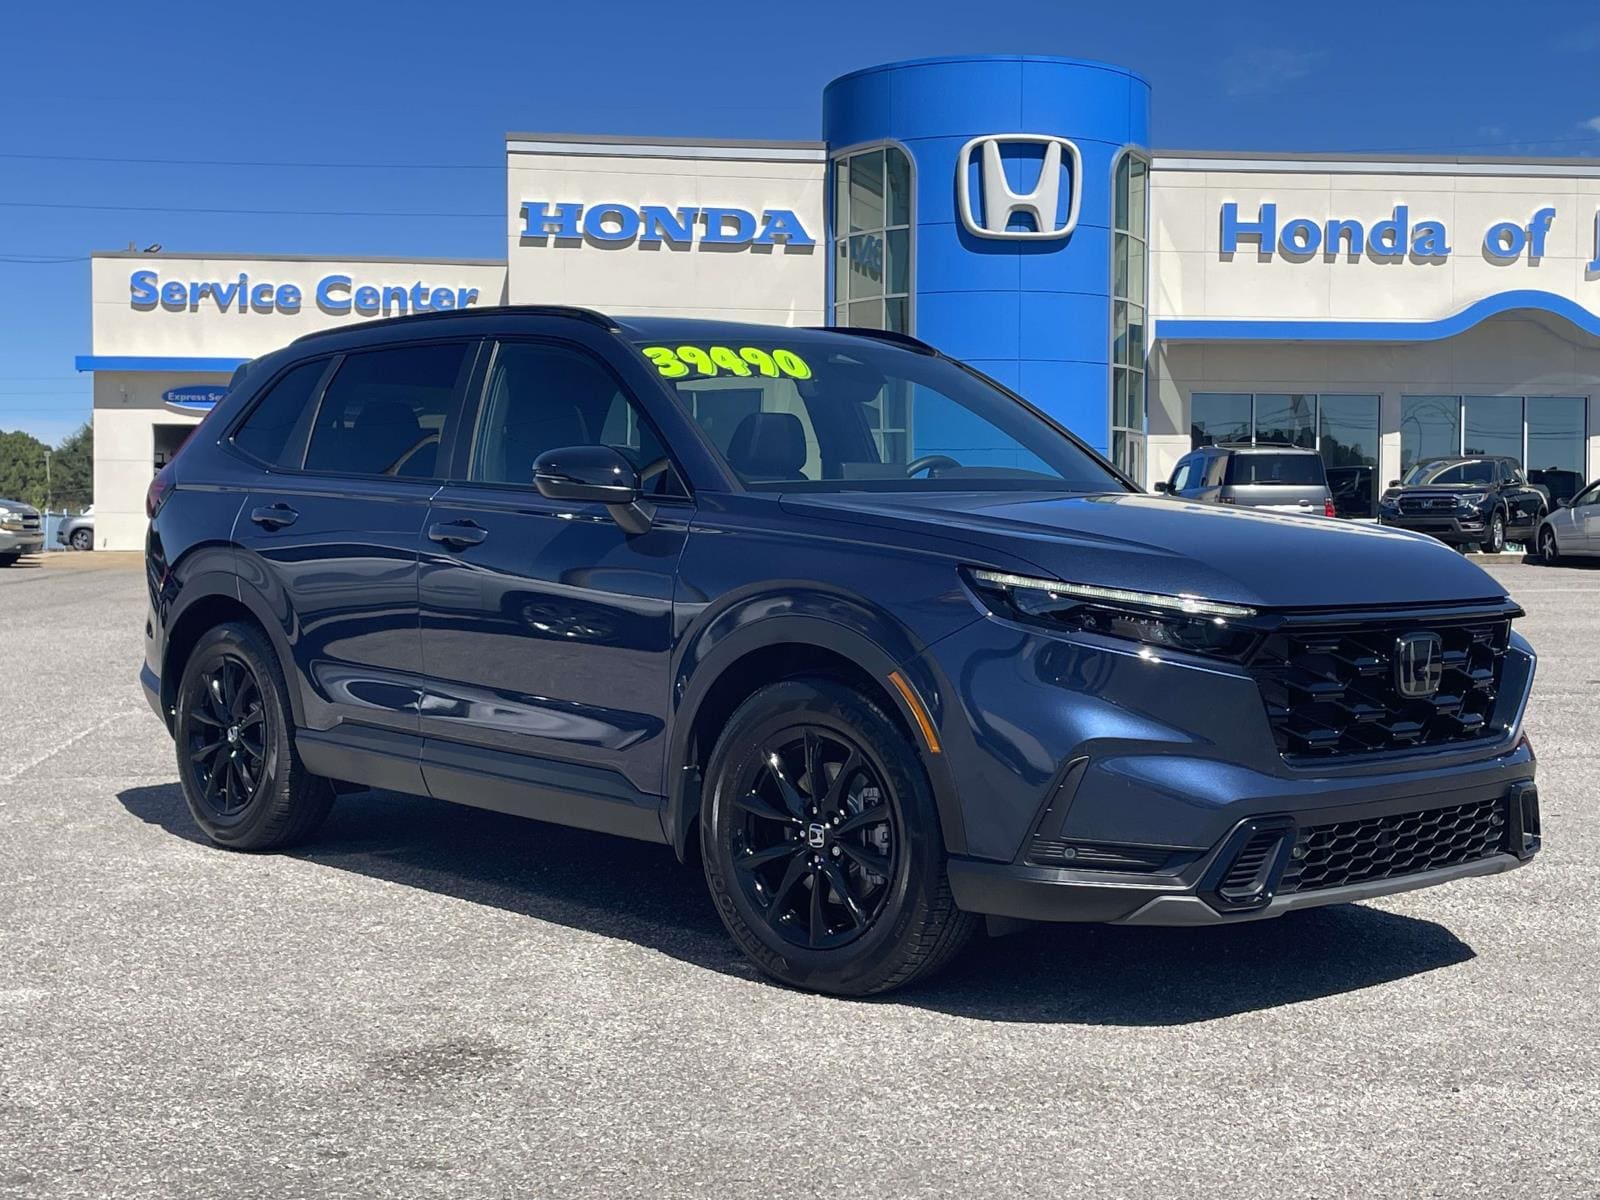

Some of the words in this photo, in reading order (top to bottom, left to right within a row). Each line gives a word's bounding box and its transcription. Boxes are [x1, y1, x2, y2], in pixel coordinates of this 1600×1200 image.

[520, 201, 814, 247] HONDA
[1221, 202, 1451, 256] Honda
[1485, 207, 1556, 257] of
[130, 270, 302, 308] Service
[316, 274, 479, 312] Center
[642, 345, 812, 380] 39490
[167, 391, 206, 402] Express
